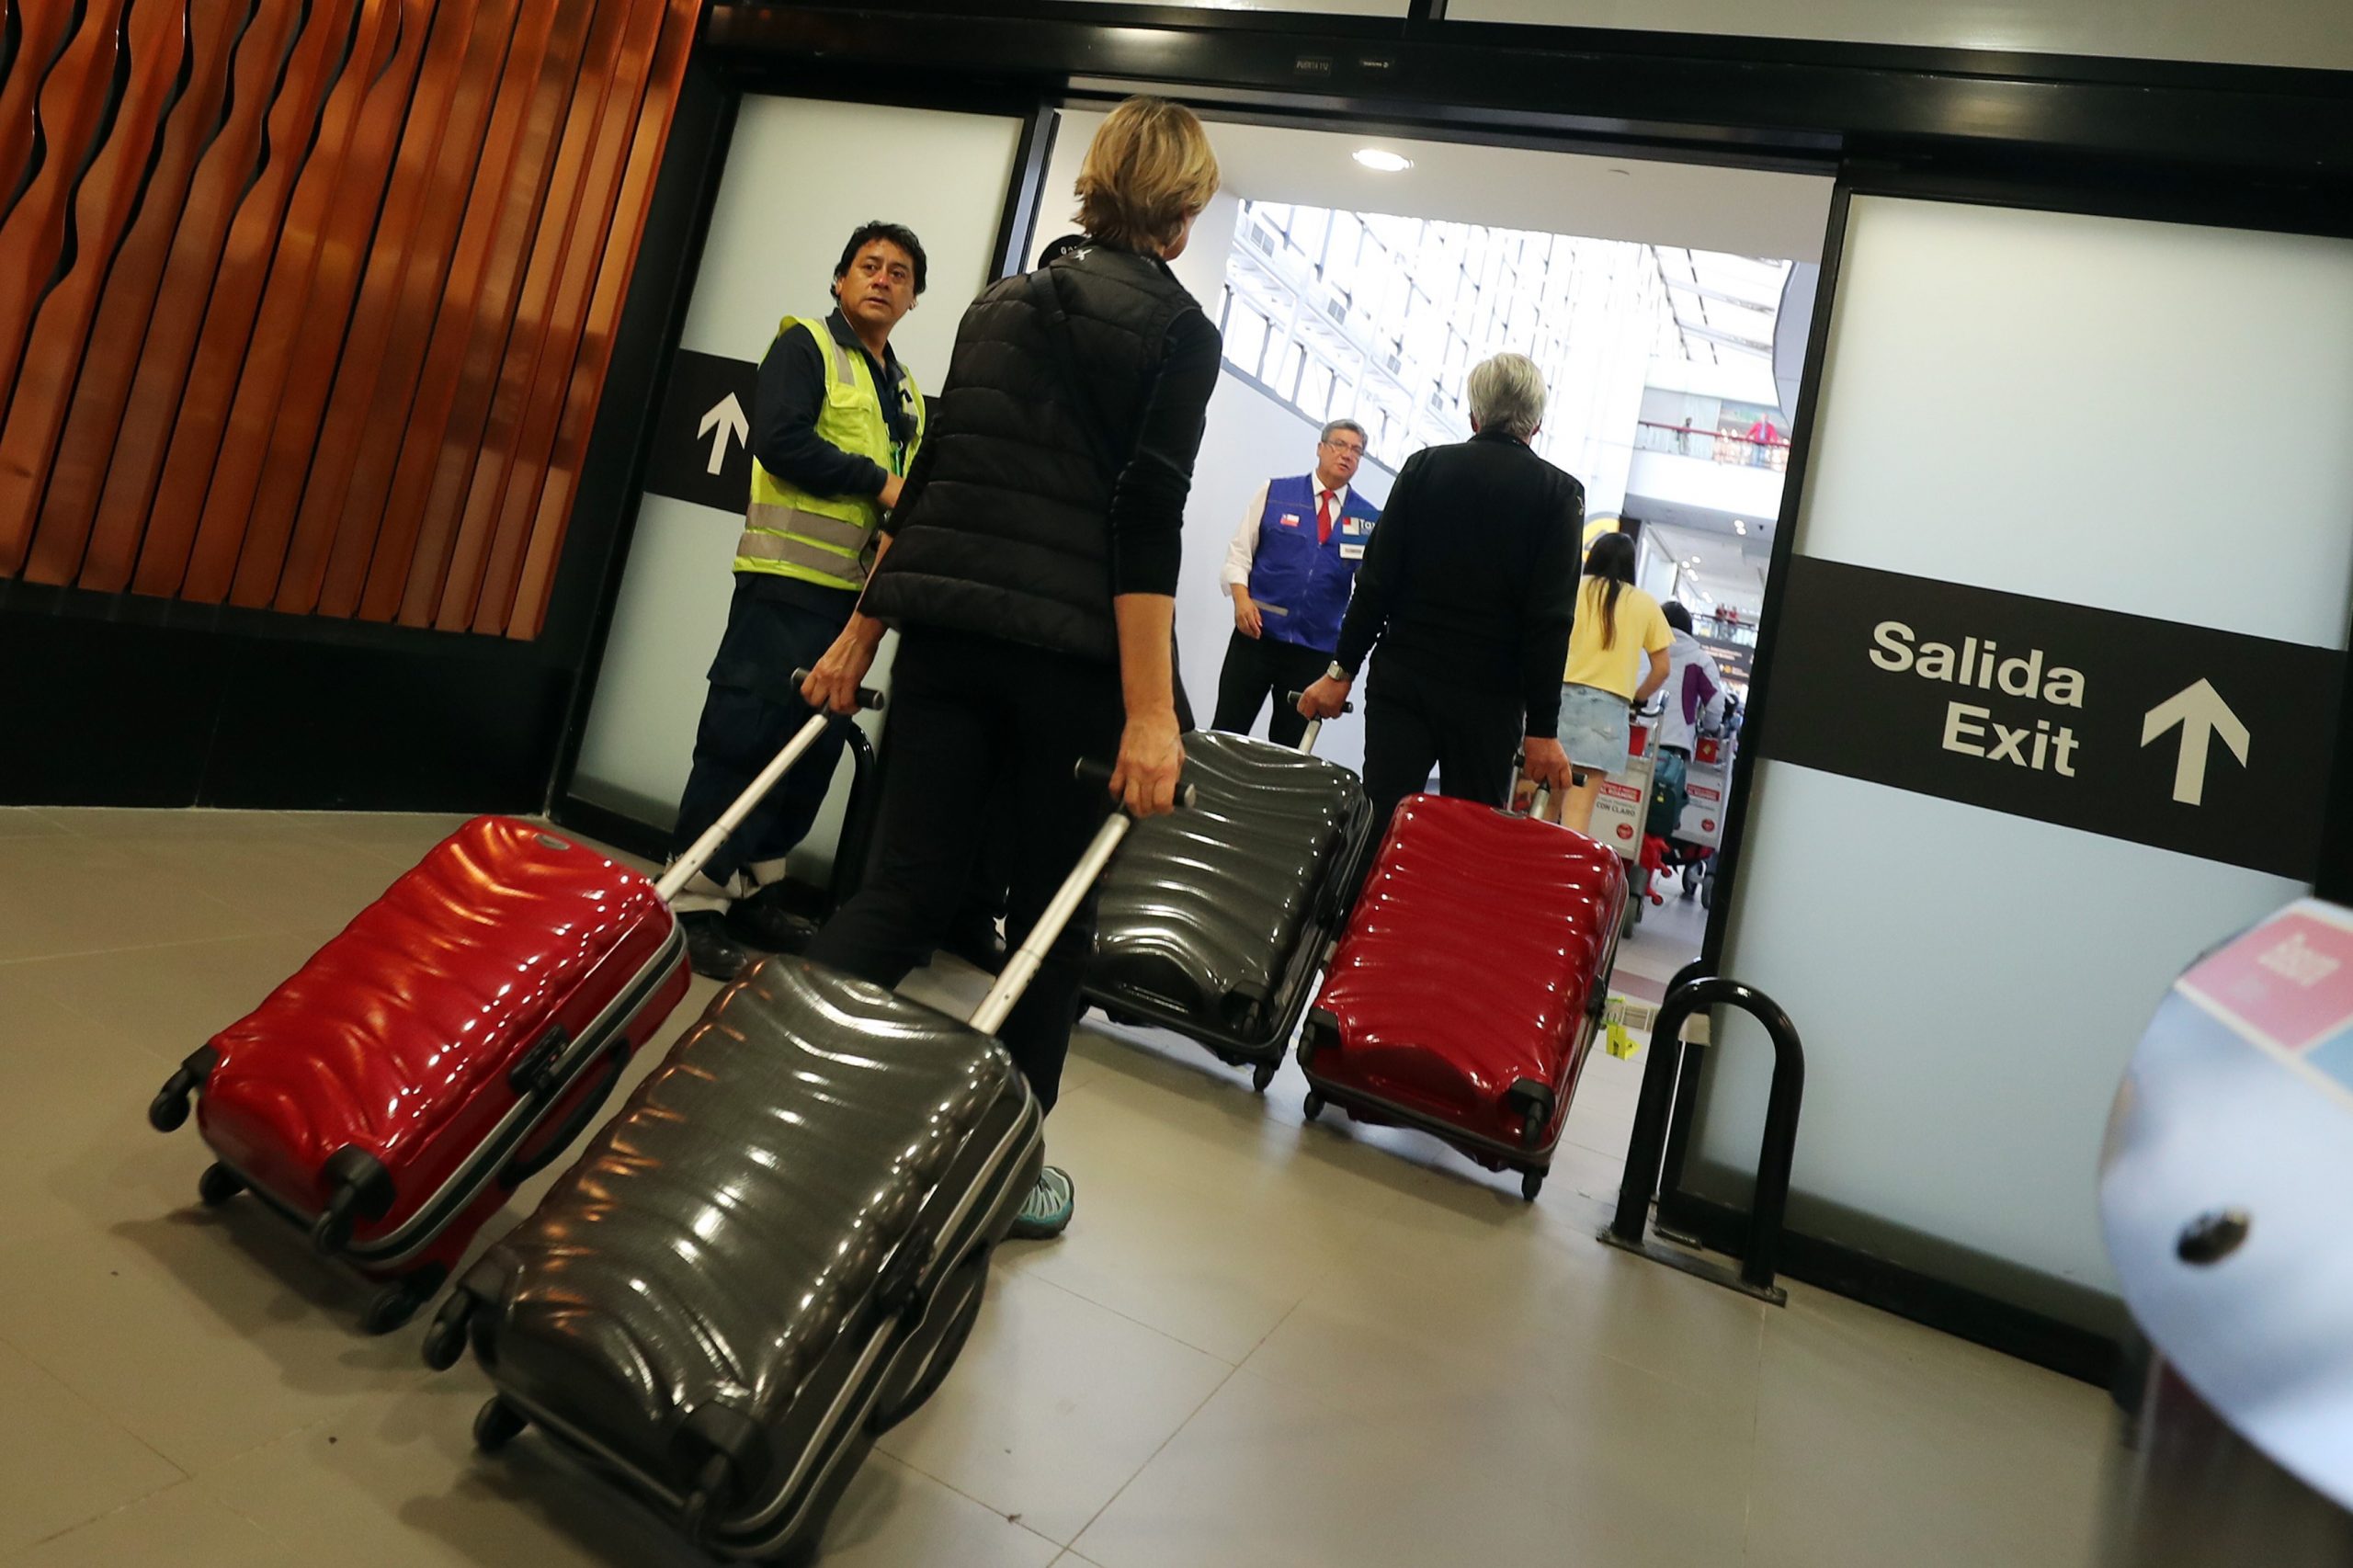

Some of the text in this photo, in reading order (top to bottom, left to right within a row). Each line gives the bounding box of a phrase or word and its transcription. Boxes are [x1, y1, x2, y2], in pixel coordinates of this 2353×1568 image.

[1869, 620, 2086, 708] Salida
[1942, 700, 2079, 778] Exit
[1611, 805, 1636, 817] CLARO
